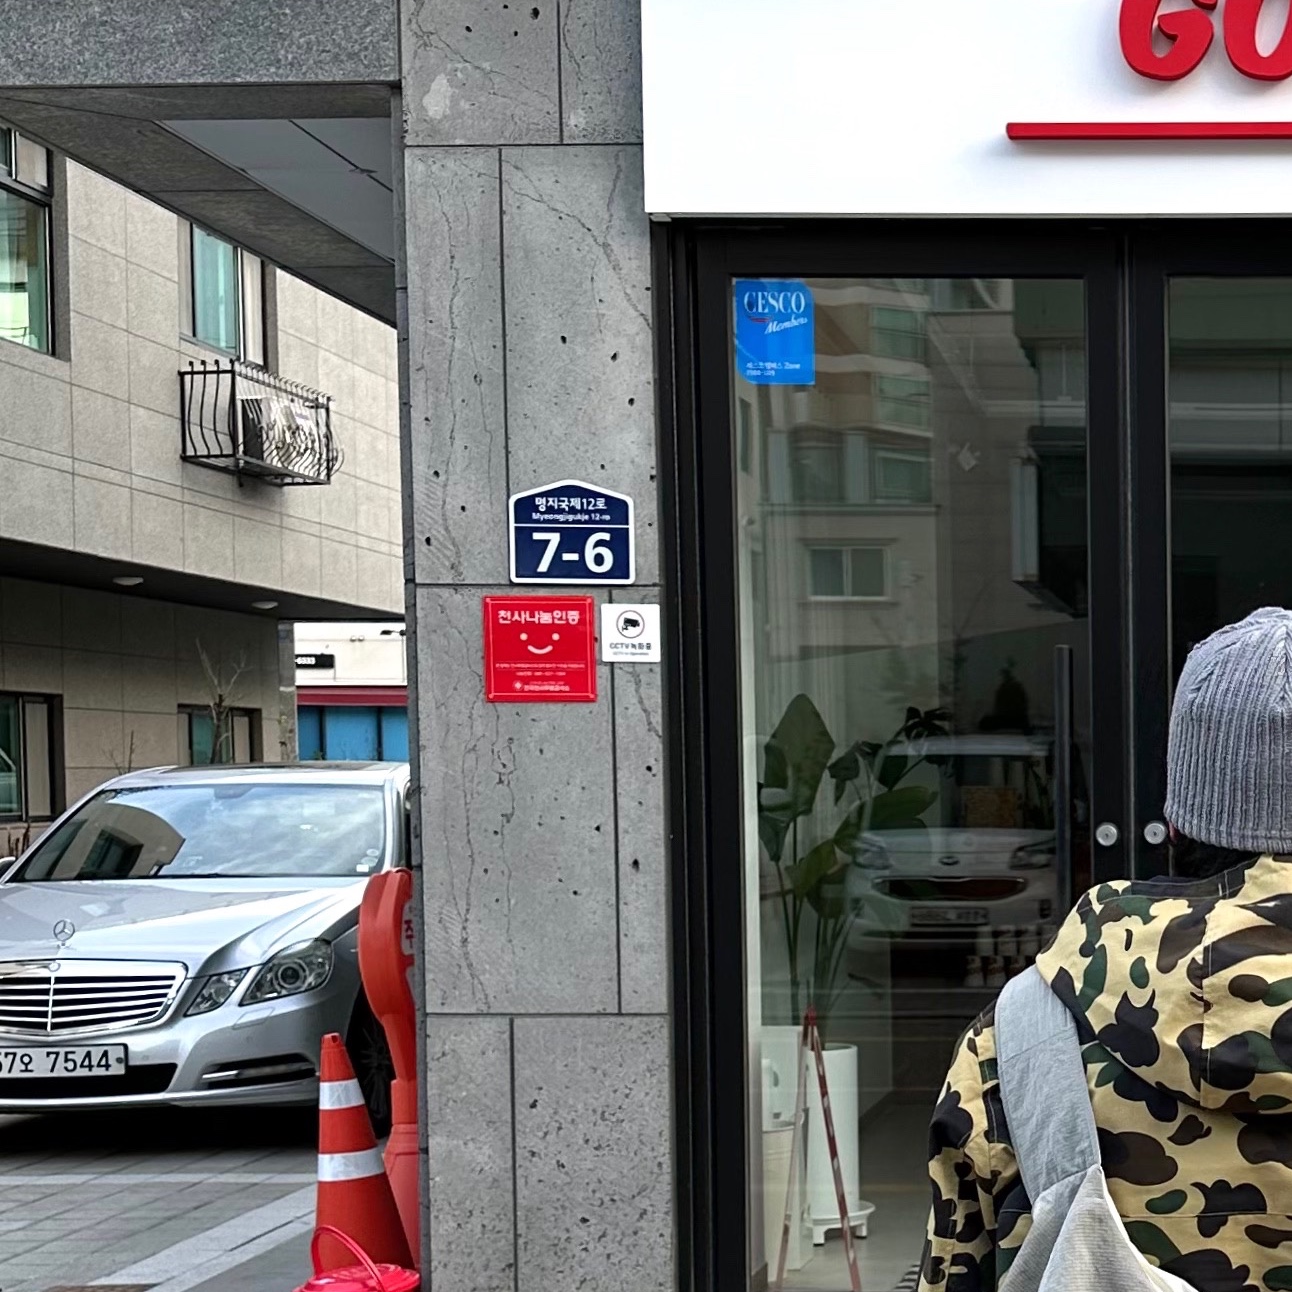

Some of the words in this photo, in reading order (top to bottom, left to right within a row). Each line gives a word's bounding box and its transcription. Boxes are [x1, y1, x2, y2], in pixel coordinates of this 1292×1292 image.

[743, 291, 805, 313] CESCO
[765, 315, 808, 333] Members
[534, 497, 608, 512] 명지국제12로
[532, 532, 614, 574] 7-6
[497, 609, 580, 625] 천사나눔인증
[609, 642, 630, 650] CCTV
[46, 1049, 112, 1073] 7544
